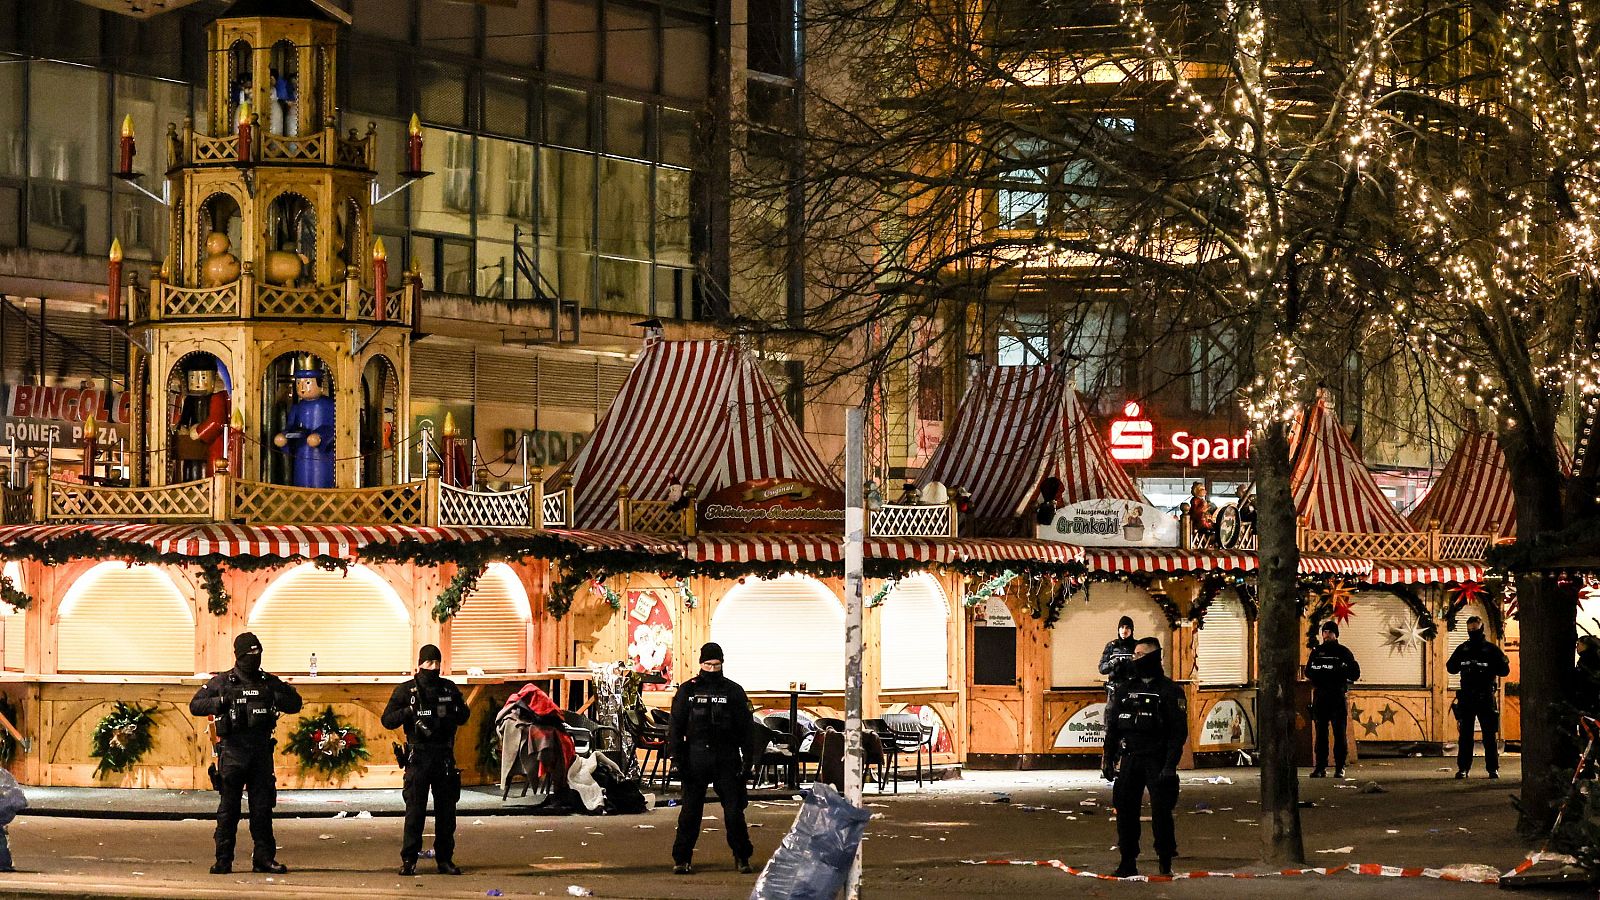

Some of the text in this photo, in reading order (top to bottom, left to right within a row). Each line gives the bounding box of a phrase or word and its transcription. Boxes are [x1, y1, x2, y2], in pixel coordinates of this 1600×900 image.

[5, 419, 118, 445] DÖNER PZA
[1056, 516, 1119, 535] Grünkohl
